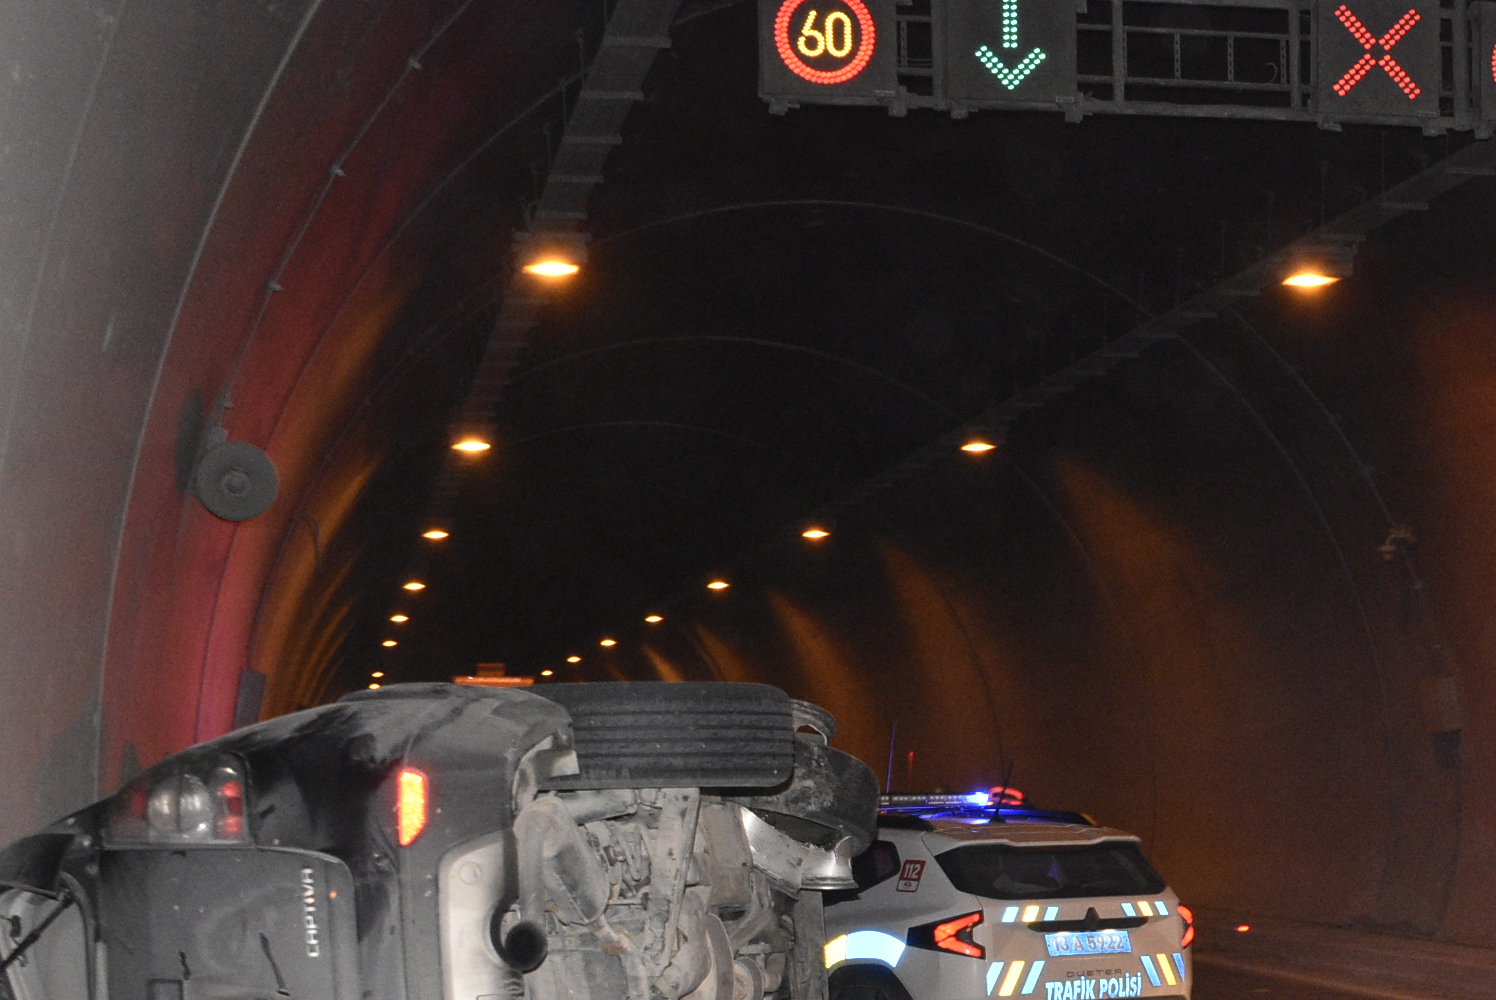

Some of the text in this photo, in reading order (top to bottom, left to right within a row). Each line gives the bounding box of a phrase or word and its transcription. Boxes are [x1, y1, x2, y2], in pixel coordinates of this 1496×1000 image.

[797, 10, 852, 58] 60
[903, 863, 921, 878] 112
[301, 868, 319, 957] CAPTIVA
[1052, 935, 1124, 952] 13 A 5922
[1066, 968, 1123, 978] DUSTER
[1099, 972, 1142, 999] POLİSİ
